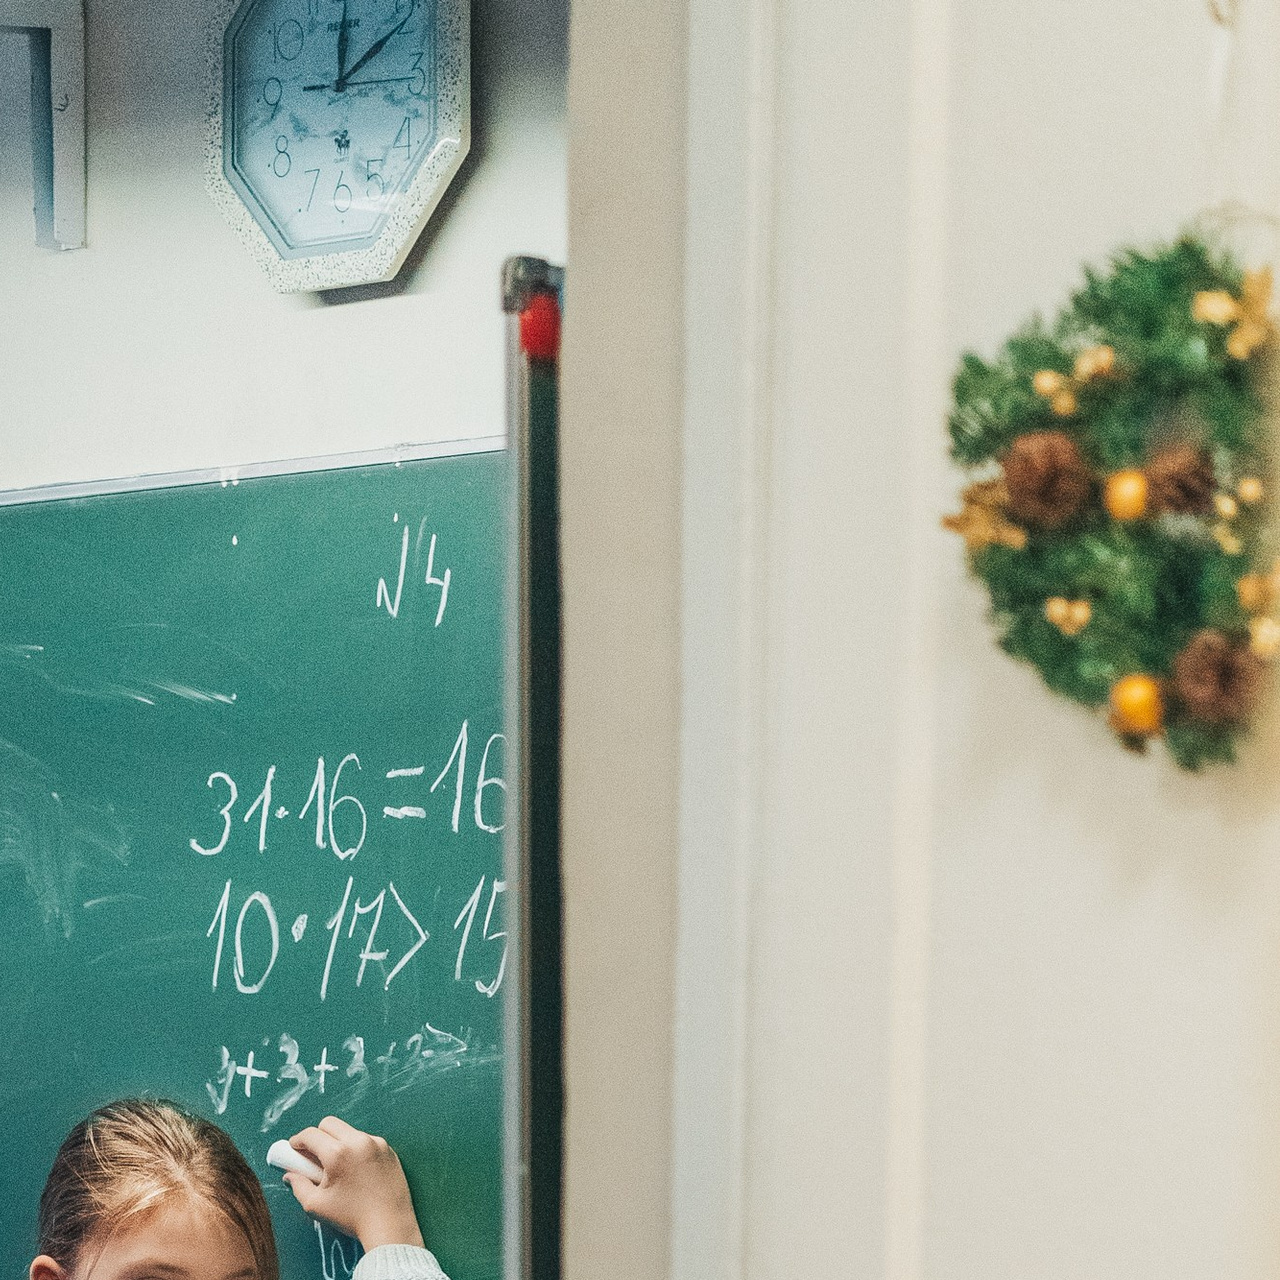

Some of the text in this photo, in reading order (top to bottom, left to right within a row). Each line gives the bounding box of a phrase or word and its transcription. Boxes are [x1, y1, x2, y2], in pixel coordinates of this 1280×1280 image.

[272, 19, 305, 62] 10
[408, 52, 426, 96] 3
[262, 77, 283, 119] 9
[273, 134, 292, 178] 8
[393, 116, 412, 159] 4
[304, 168, 320, 212] 7
[333, 170, 353, 213] 6
[366, 159, 385, 202] 5
